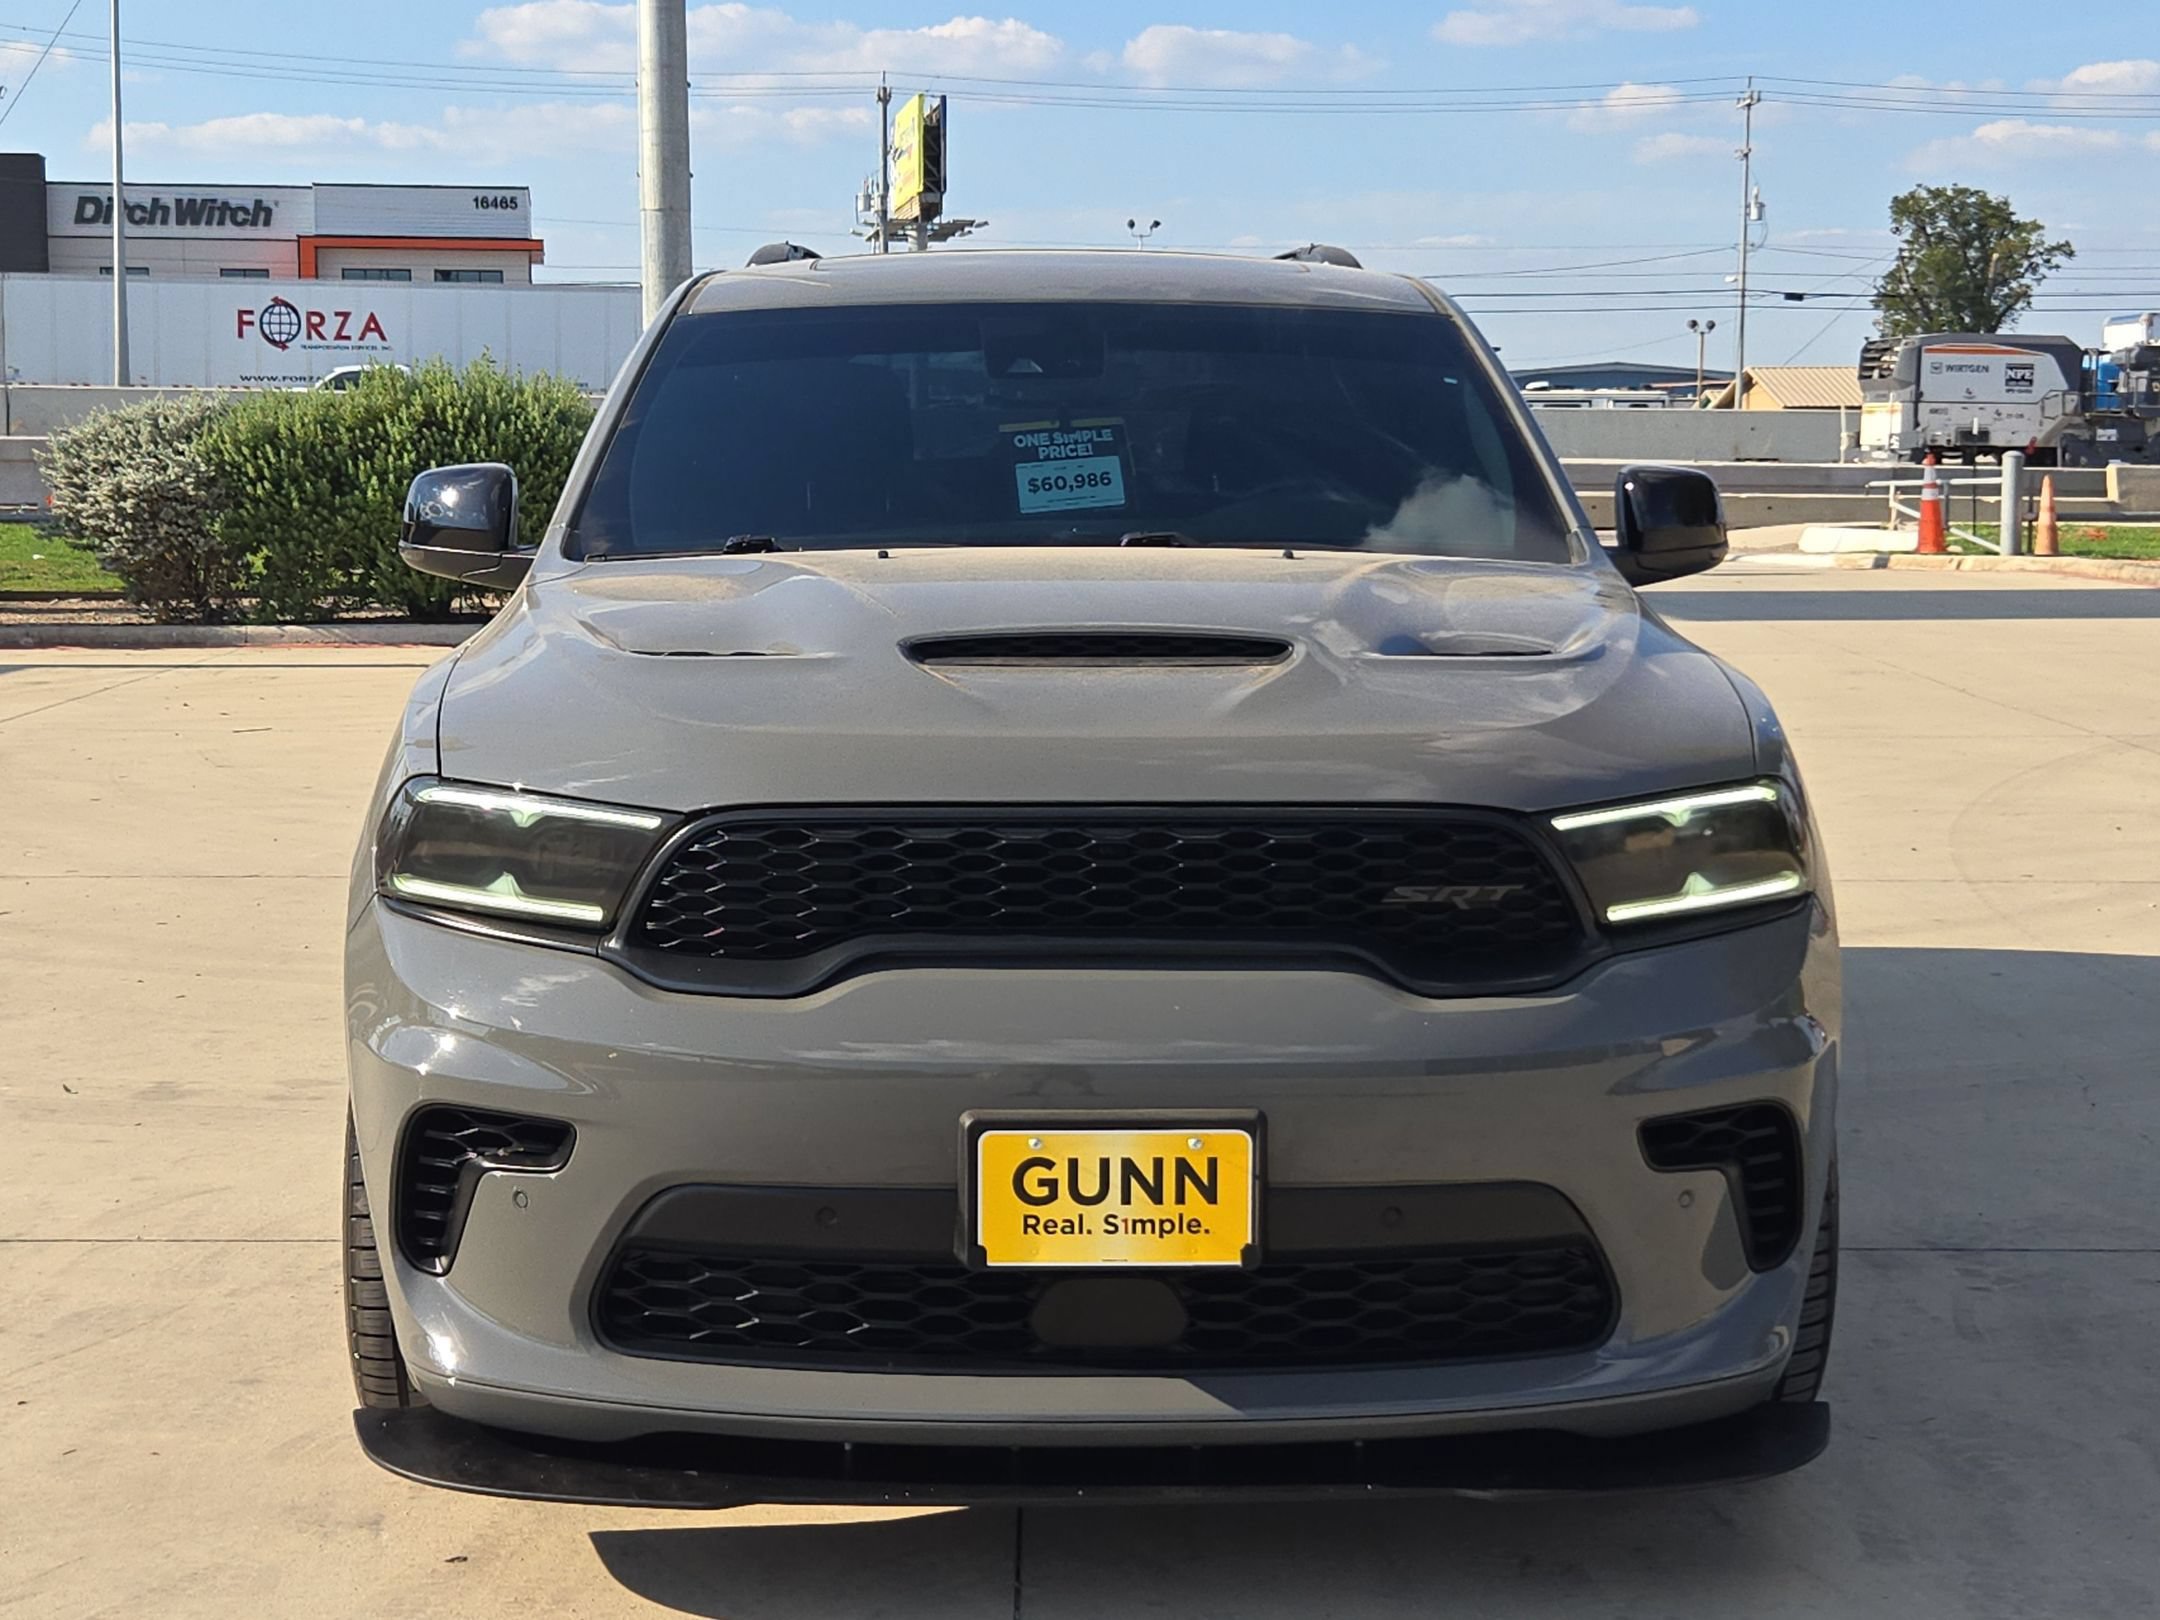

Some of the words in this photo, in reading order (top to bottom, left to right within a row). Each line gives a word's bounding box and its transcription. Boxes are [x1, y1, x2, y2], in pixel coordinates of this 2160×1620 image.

[74, 196, 170, 226] Dich
[174, 198, 274, 227] Witch
[472, 195, 518, 210] 16465
[237, 300, 388, 348] FORZA
[1945, 363, 1990, 374] WIRTGEN
[2004, 368, 2034, 380] NPE
[1013, 432, 1051, 448] ONE
[1038, 443, 1094, 460] PRICE!
[1027, 471, 1113, 495] $60,986
[1381, 885, 1525, 910] SRT
[1011, 1156, 1219, 1207] GUNN
[1022, 1214, 1093, 1235] Real.
